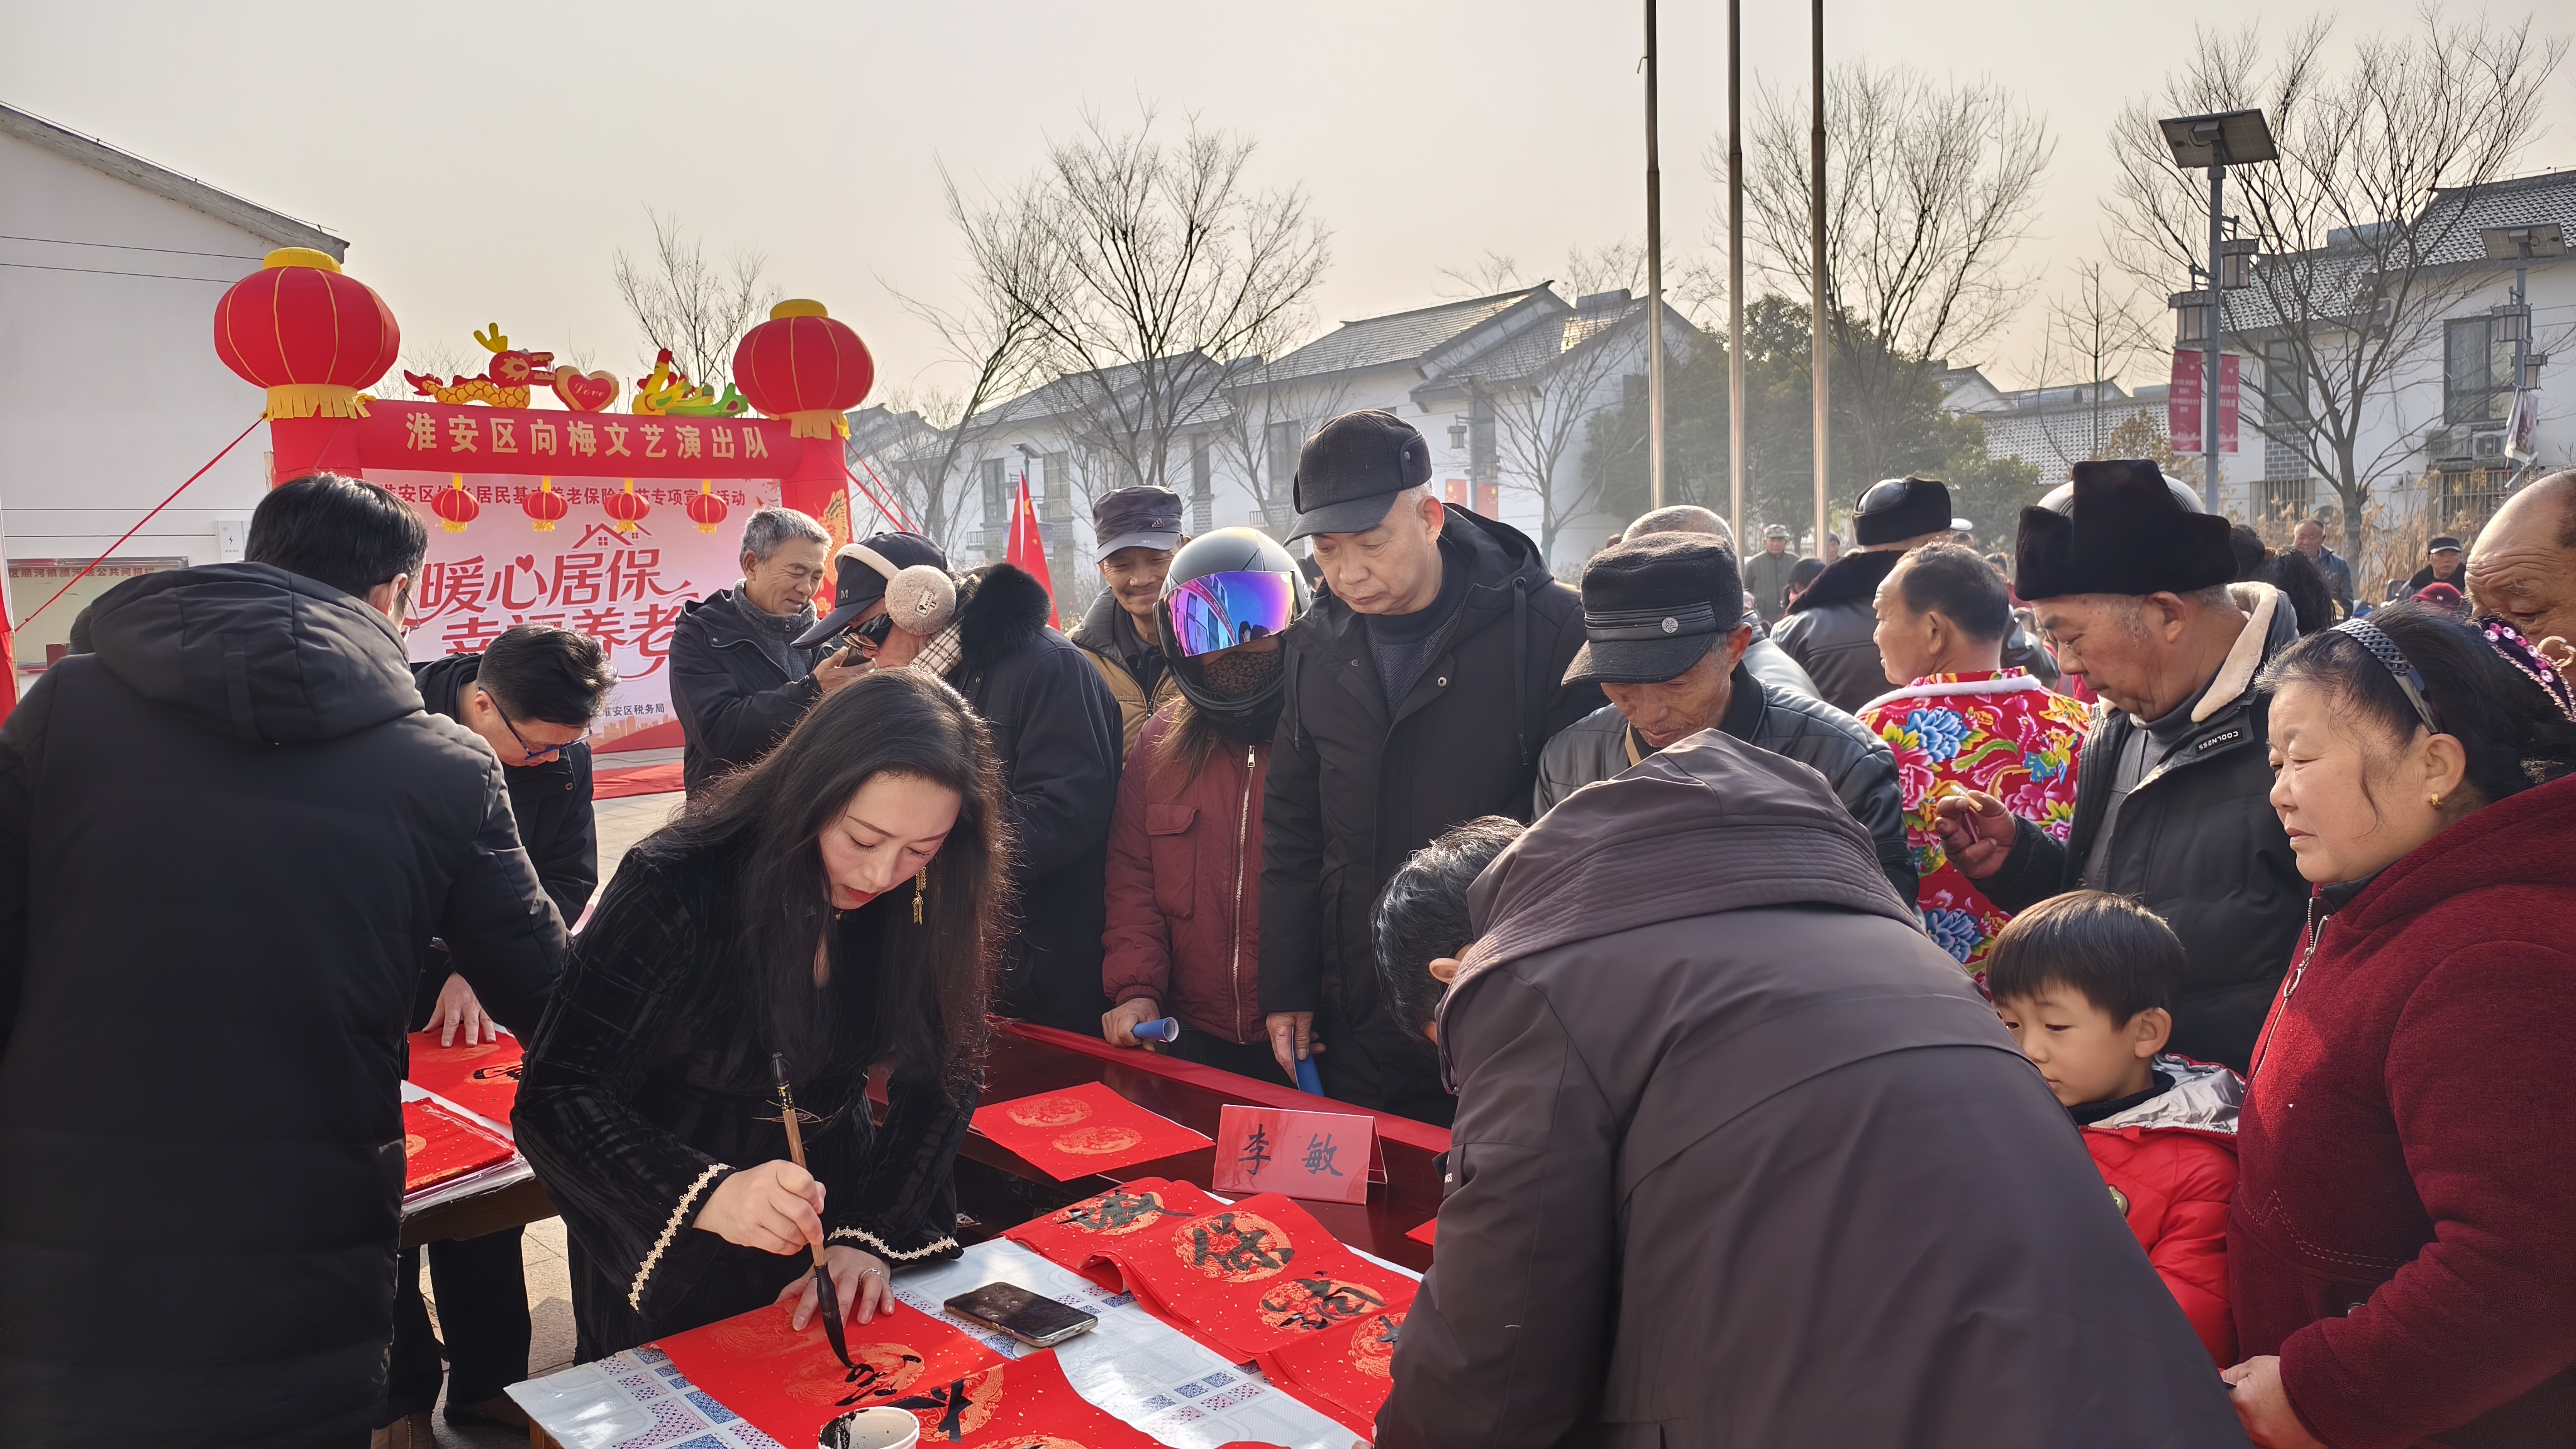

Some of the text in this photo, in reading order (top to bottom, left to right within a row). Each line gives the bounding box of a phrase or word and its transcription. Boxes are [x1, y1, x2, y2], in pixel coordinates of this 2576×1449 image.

[575, 382, 604, 397] Love
[406, 413, 769, 460] 淮安区向梅文艺演出队
[402, 549, 692, 625] 暖心居保
[841, 590, 848, 599] M
[442, 593, 699, 679] 幸养老
[2199, 731, 2238, 750] COOLNESS
[1238, 1123, 1343, 1177] 李敏
